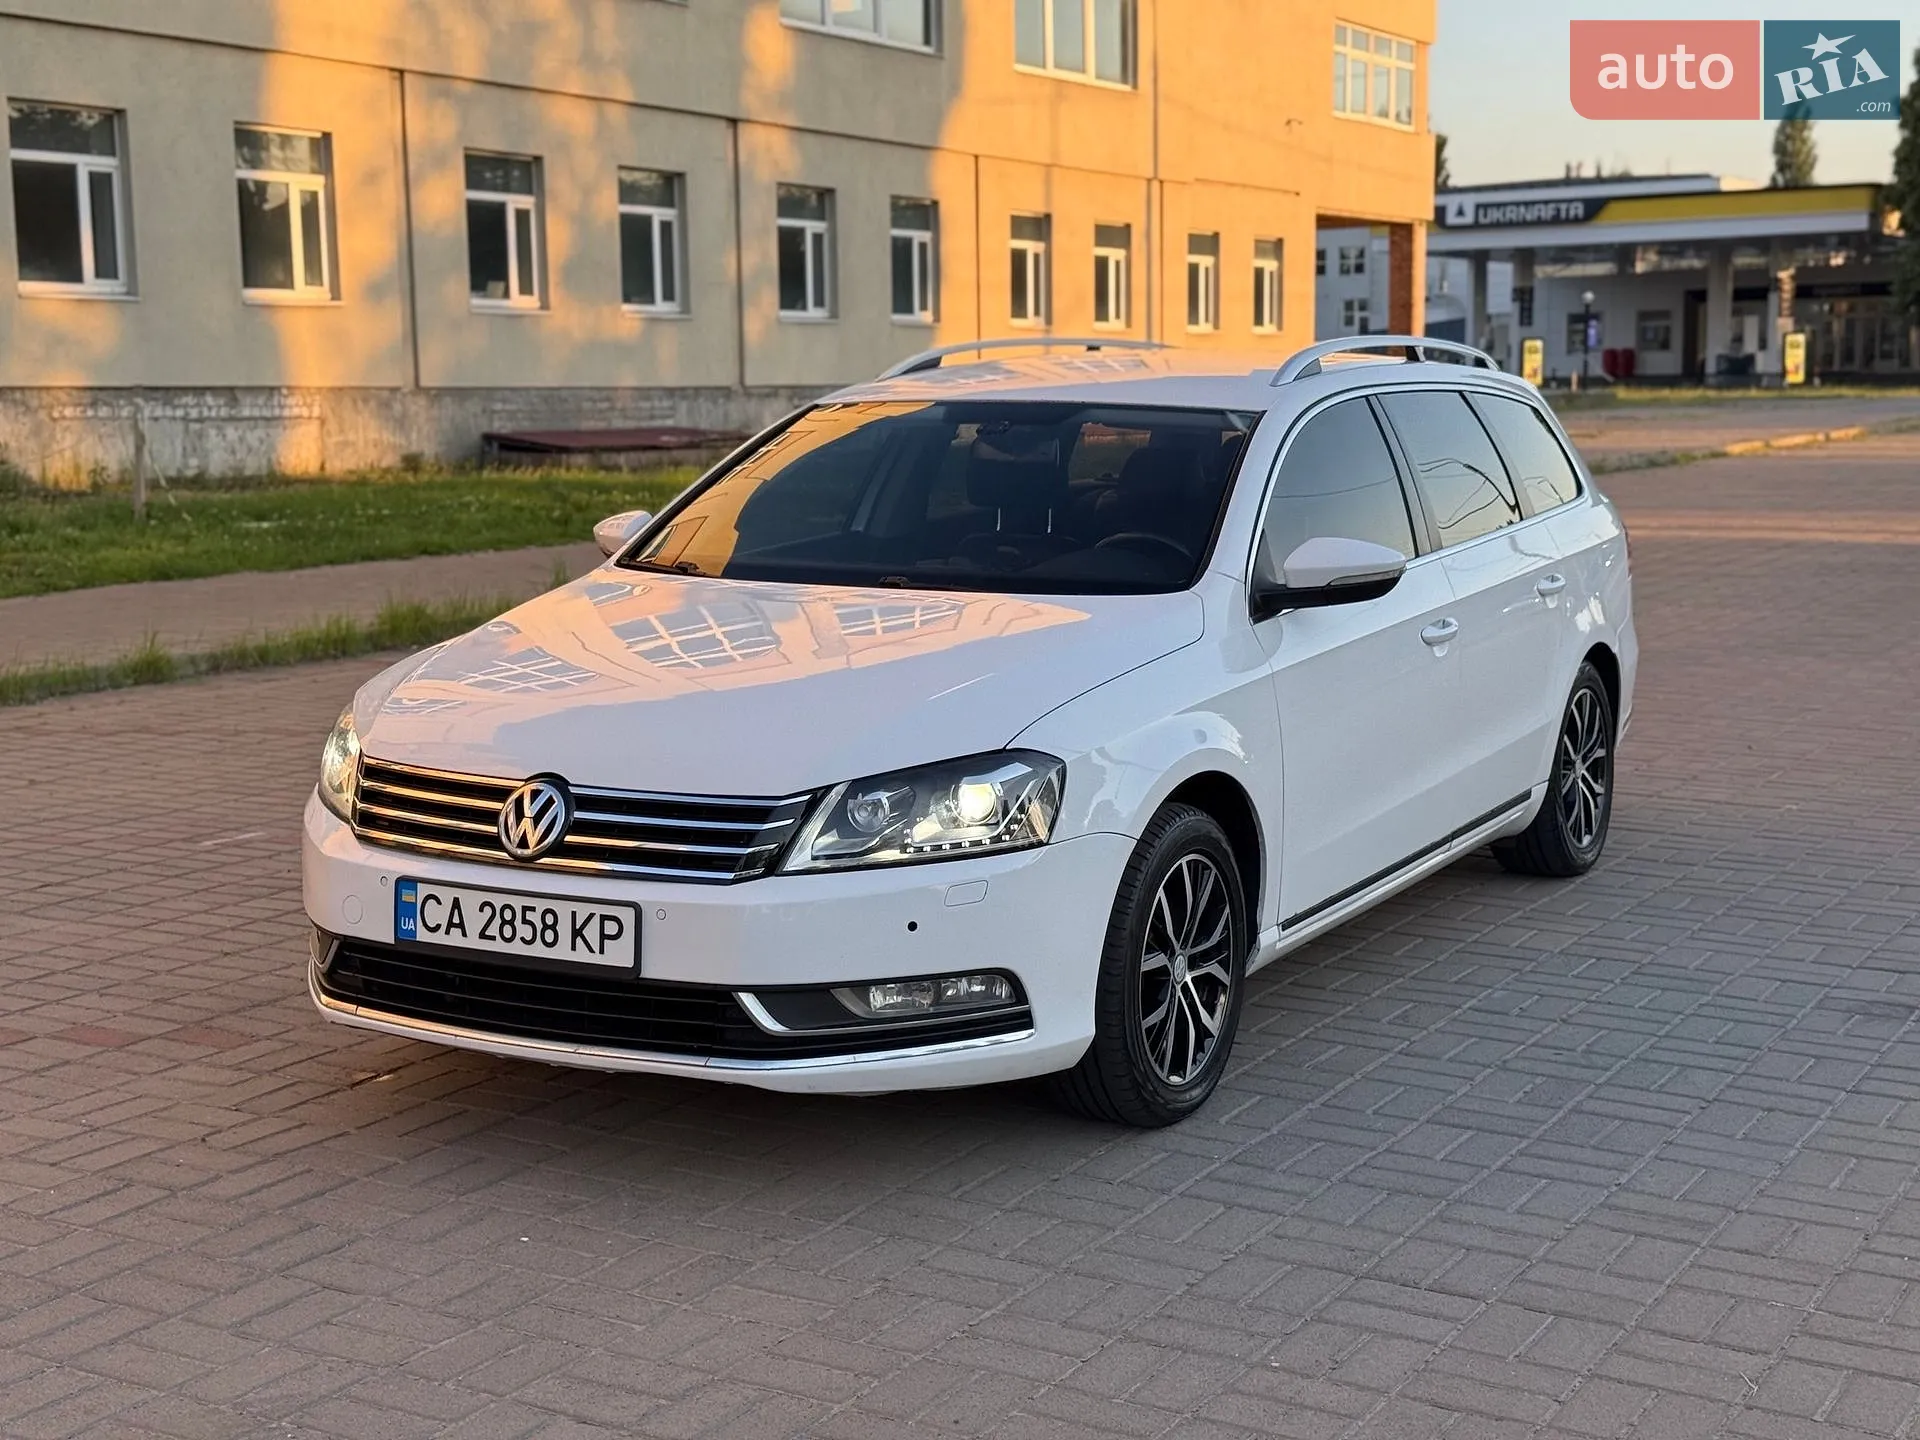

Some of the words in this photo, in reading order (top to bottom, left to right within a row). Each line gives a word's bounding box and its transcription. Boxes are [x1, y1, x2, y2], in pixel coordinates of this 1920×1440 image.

[1477, 201, 1585, 225] UKRNAFTA
[400, 916, 416, 932] UA
[419, 893, 468, 938] CA
[478, 900, 560, 948] 2858
[570, 910, 625, 955] KP
